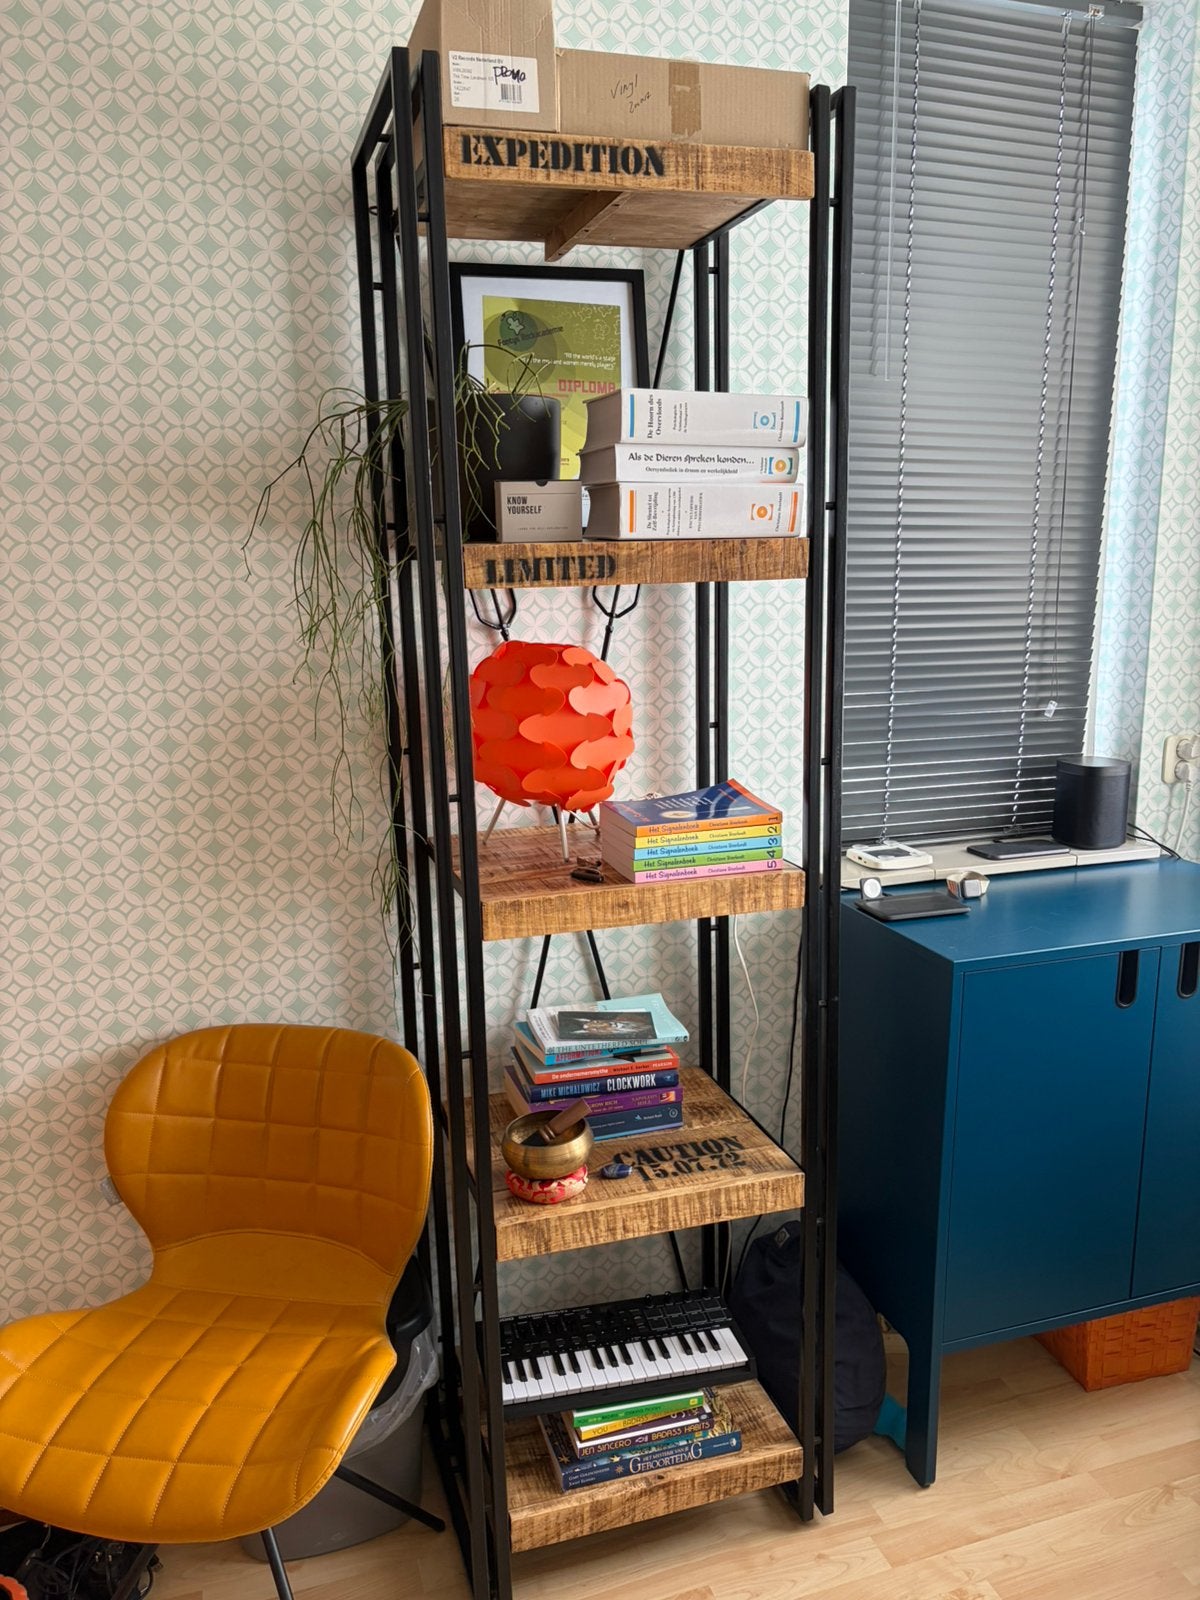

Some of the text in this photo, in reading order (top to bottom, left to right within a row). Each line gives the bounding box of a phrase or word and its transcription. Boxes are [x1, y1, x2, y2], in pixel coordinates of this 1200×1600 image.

[461, 134, 665, 176] EXPEDITION
[647, 429, 654, 439] De
[628, 452, 755, 464] Als de Dieren spreken konden...
[507, 496, 528, 505] KNOW
[507, 505, 542, 515] YOURSELF
[486, 555, 616, 585] LIMITED
[660, 823, 700, 834] Signalenboek
[767, 826, 778, 834] 2
[647, 837, 658, 845] Het
[660, 834, 699, 845] Signalenboek
[768, 837, 778, 846] 3
[647, 848, 658, 856] Het
[659, 845, 699, 856] Signalenboek
[766, 849, 776, 858] 4
[644, 860, 655, 868] Het
[656, 857, 697, 868] Signalenboek
[766, 860, 777, 868] 5
[658, 868, 698, 880] Signalenboek
[555, 1044, 572, 1053] THE
[606, 1073, 656, 1092] CLOCKWORK
[541, 1082, 600, 1098] MIKE MICHALOWICZ
[612, 1135, 745, 1166] CAUTION
[635, 1152, 747, 1181] 15.07.72
[592, 1426, 609, 1435] YOU
[581, 1446, 595, 1455] JEN
[597, 1439, 632, 1453] SINCERO
[651, 1428, 682, 1440] BADASS
[684, 1421, 711, 1434] HABITS
[629, 1441, 703, 1474] GEBOORTEDAG
